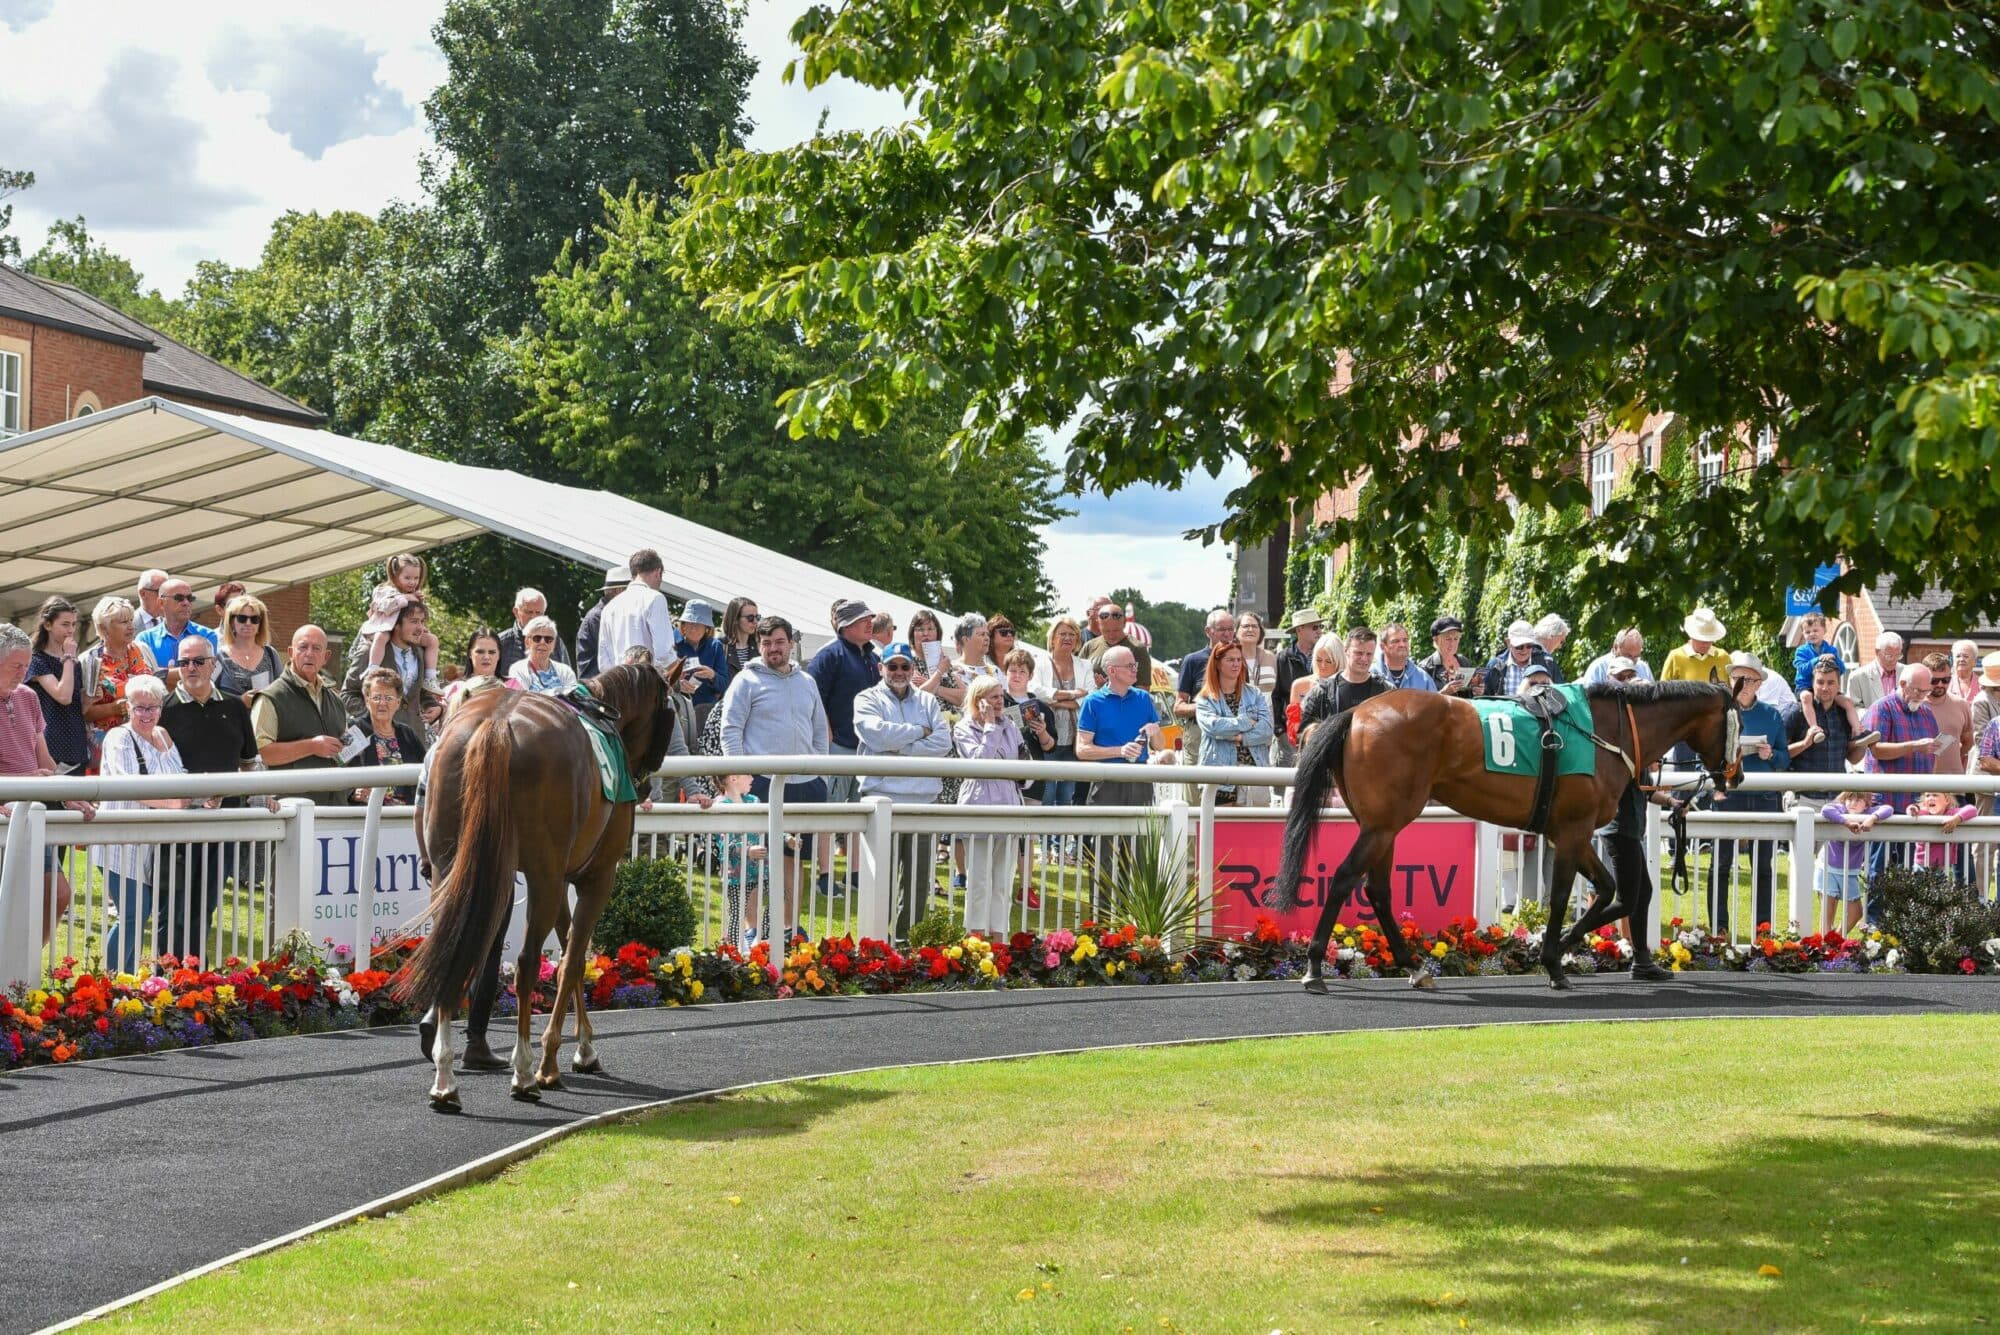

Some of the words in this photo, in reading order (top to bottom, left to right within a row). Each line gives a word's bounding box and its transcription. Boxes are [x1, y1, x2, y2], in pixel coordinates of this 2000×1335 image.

[314, 901, 400, 920] SOLICORS
[1218, 863, 1377, 920] Rcig
[1396, 864, 1458, 907] TV
